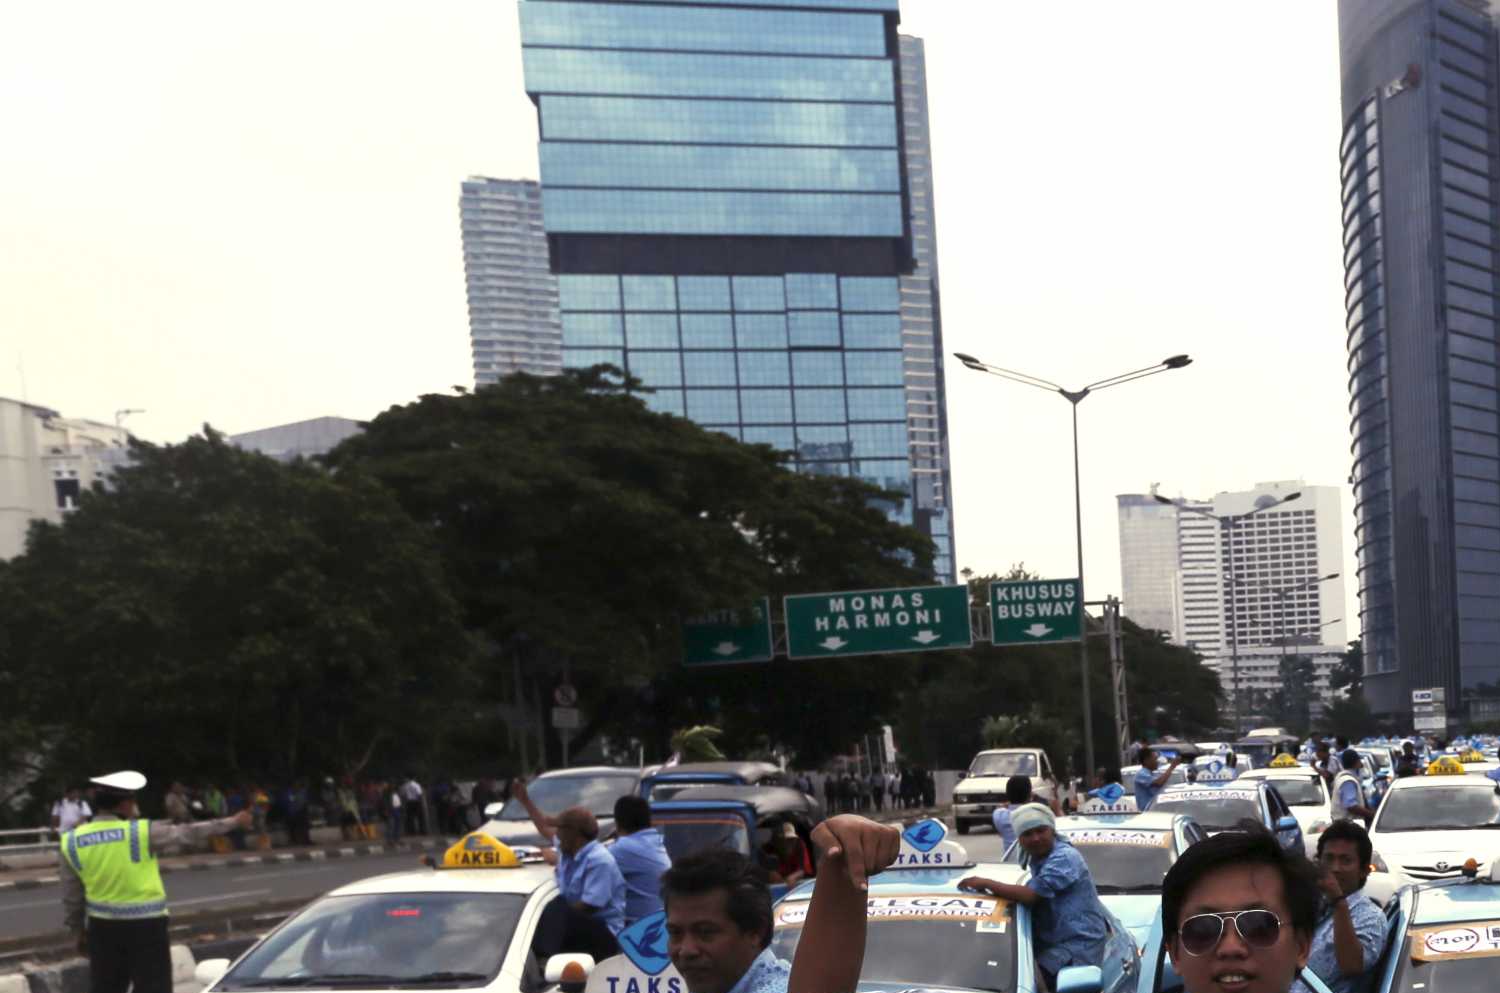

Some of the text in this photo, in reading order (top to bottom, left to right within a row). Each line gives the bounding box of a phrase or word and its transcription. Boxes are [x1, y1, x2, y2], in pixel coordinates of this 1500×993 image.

[996, 583, 1076, 601] KHUSUS
[829, 592, 925, 614] MONAS
[997, 600, 1076, 620] BUSWAY
[814, 609, 942, 632] HARMONI
[1091, 803, 1128, 812] TAKSI
[80, 829, 123, 847] POLISI
[453, 851, 500, 865] TAKSI
